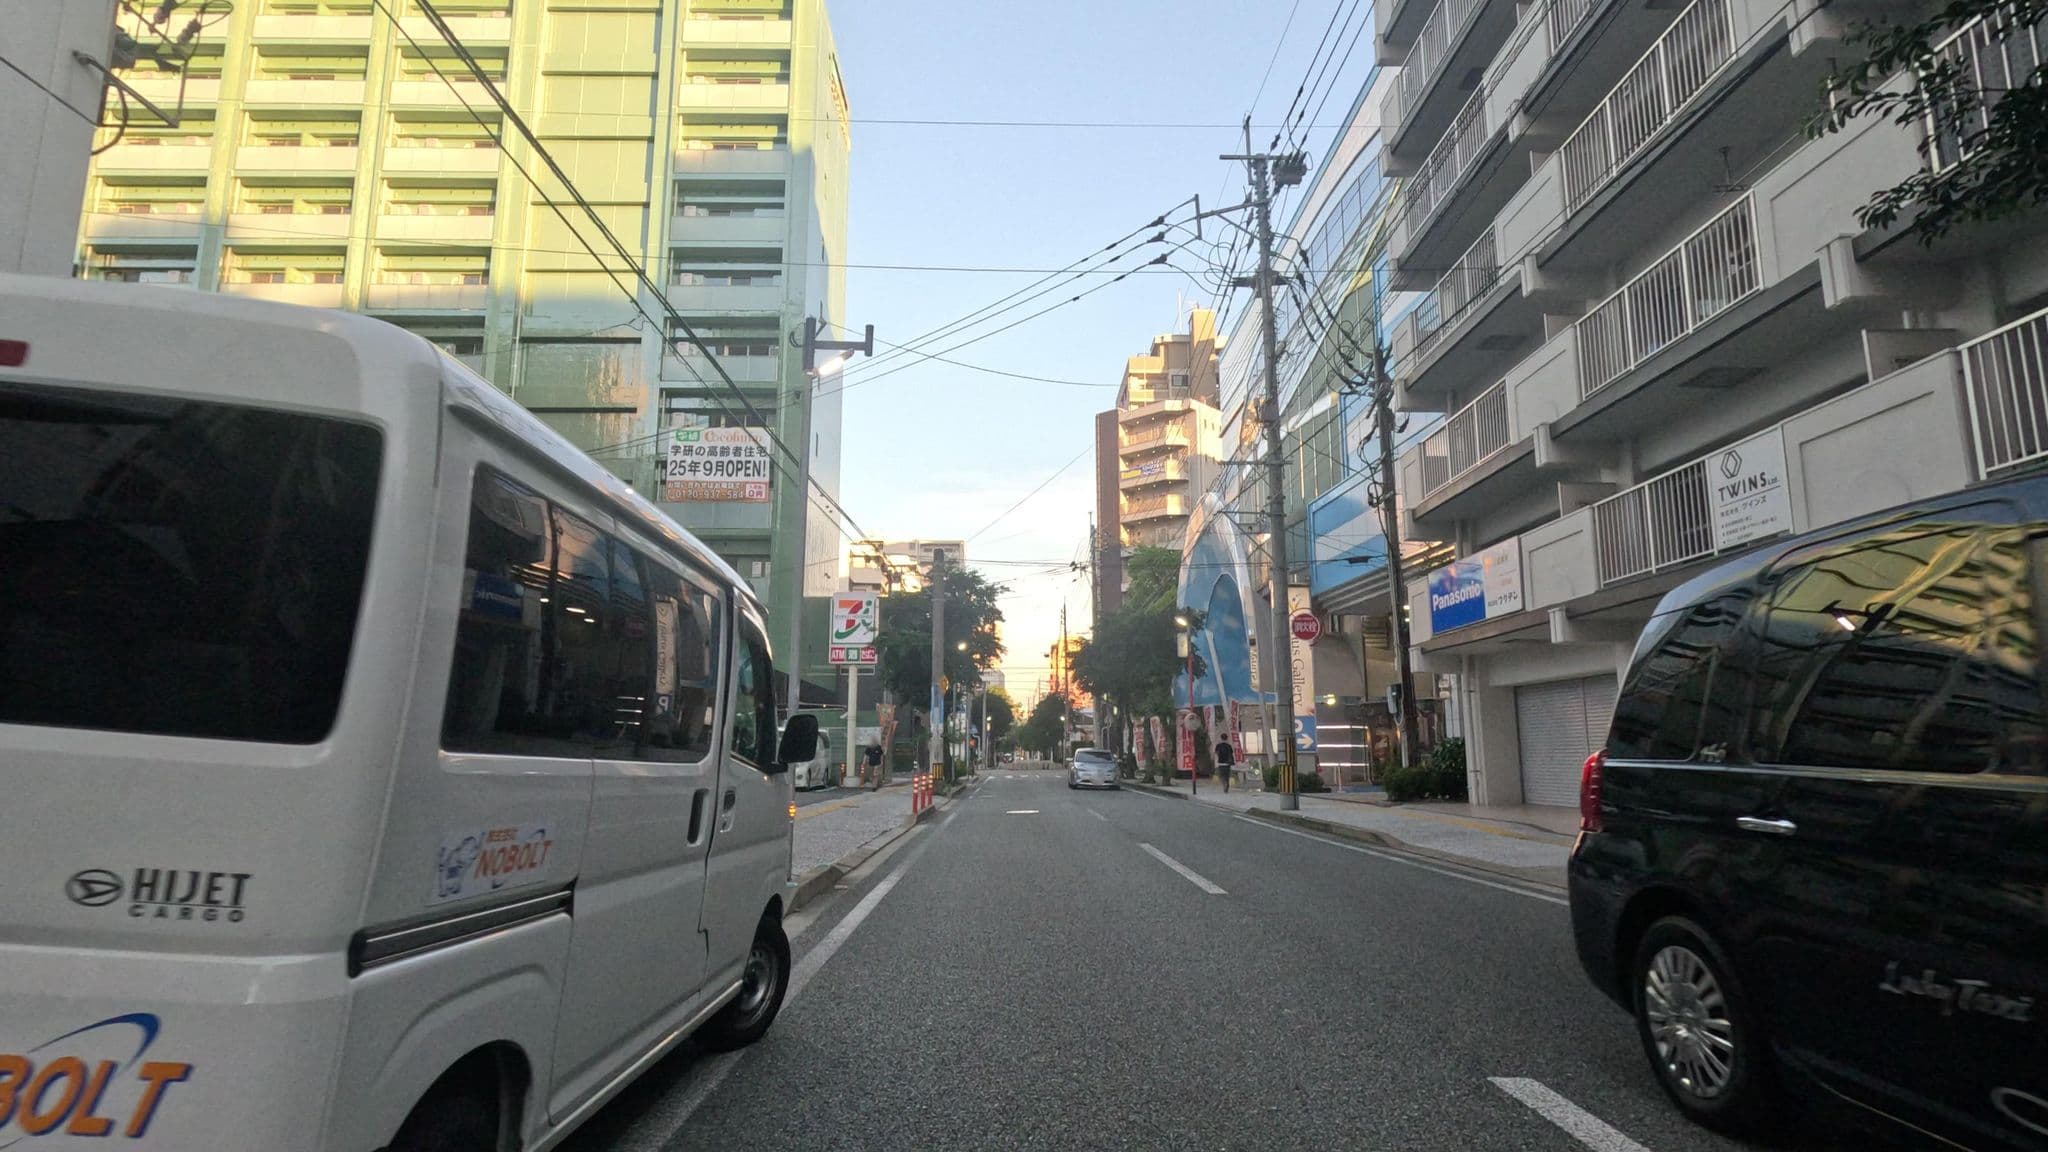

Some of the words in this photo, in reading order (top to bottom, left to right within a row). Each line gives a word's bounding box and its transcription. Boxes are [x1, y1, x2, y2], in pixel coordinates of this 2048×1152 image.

[671, 445, 767, 458] 学研の高齢者住宅
[669, 460, 766, 477] 25年9月OPEN!
[1718, 471, 1767, 502] TWINS
[1432, 580, 1481, 611] Panasonic
[1294, 620, 1317, 633] 消火栓
[831, 649, 845, 660] ATM
[1292, 659, 1306, 709] Gallery
[474, 840, 553, 880] NOBOLT
[132, 867, 253, 906] HIJET
[127, 903, 245, 923] CARGO
